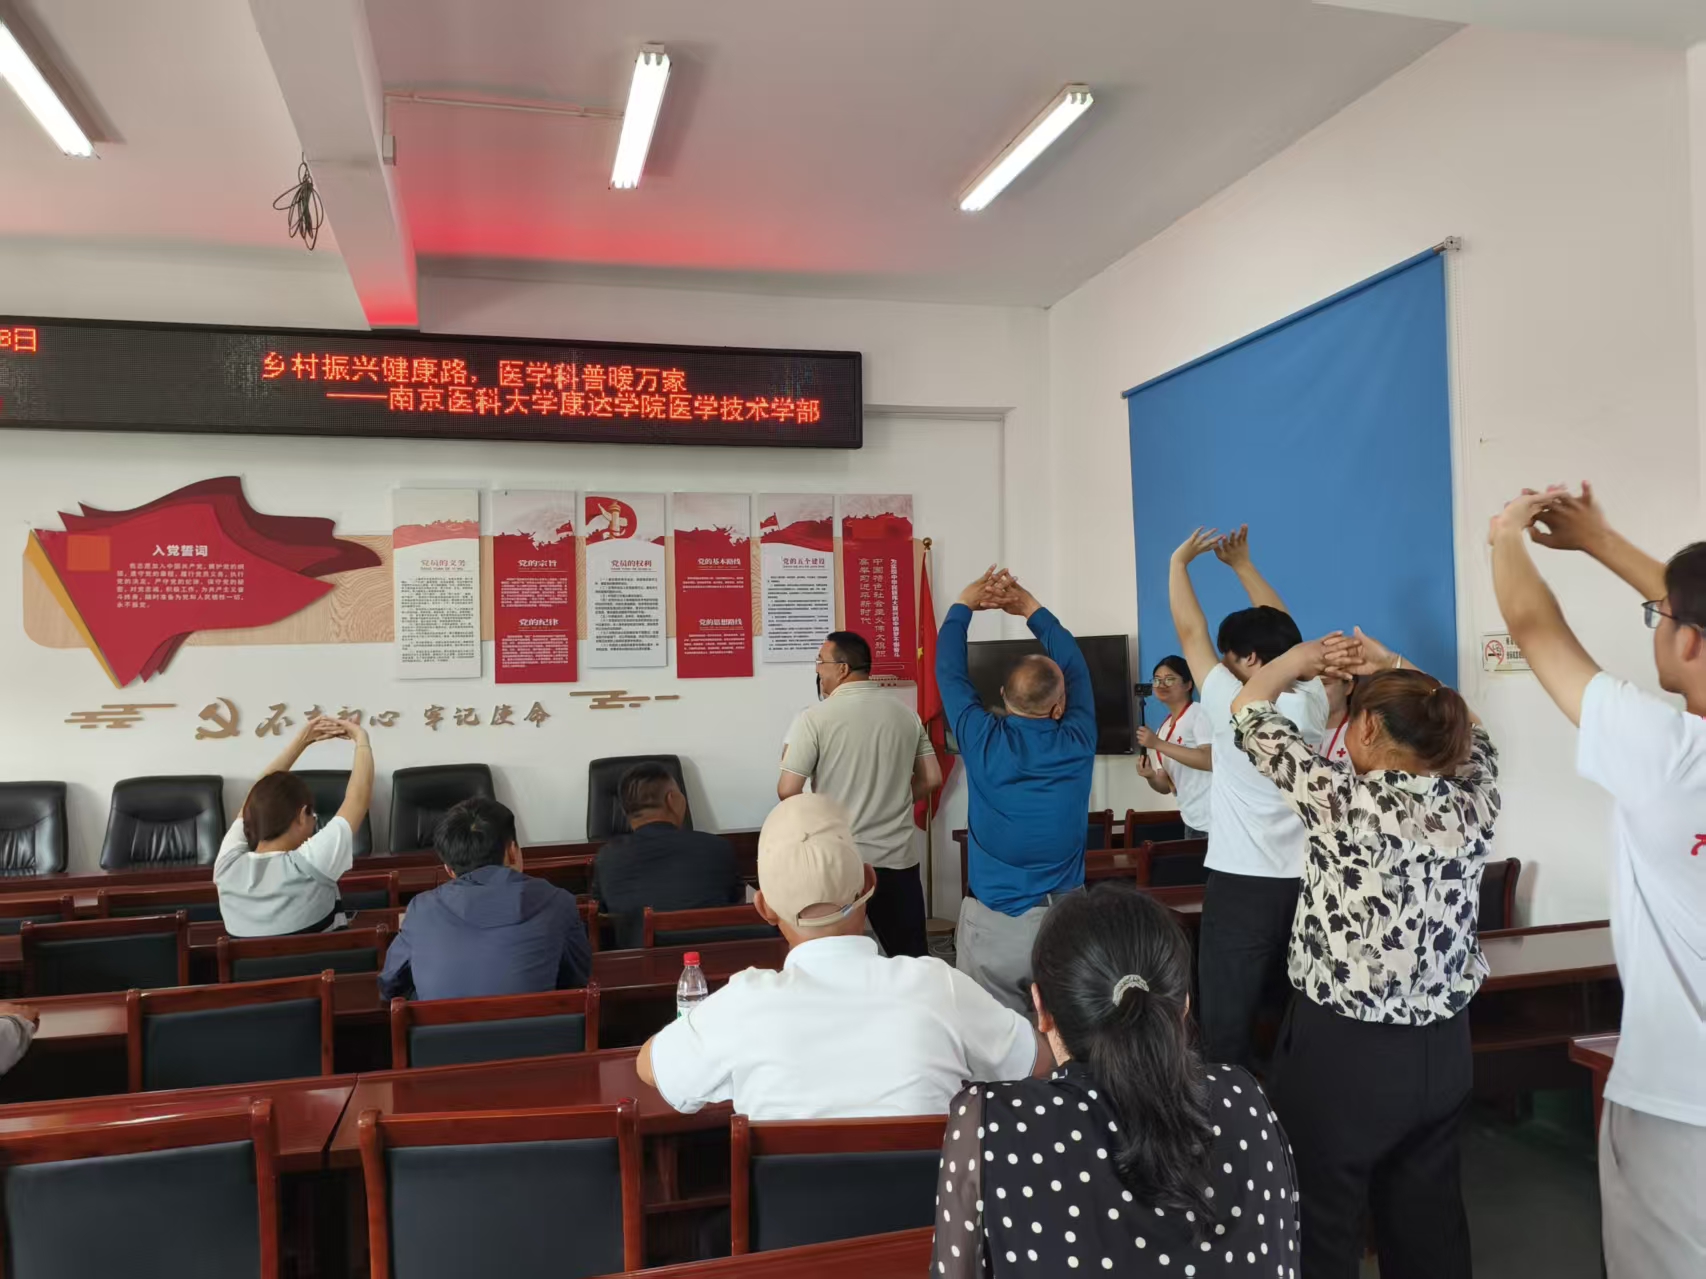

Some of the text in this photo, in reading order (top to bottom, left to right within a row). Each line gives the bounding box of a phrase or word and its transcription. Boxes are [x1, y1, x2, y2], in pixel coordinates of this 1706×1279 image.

[152, 544, 209, 557] 入党誓词
[518, 559, 557, 567] 党的宗旨
[610, 559, 652, 567] 党员的权利
[518, 618, 559, 626] 党的纪律
[423, 700, 551, 731] 牢记使命
